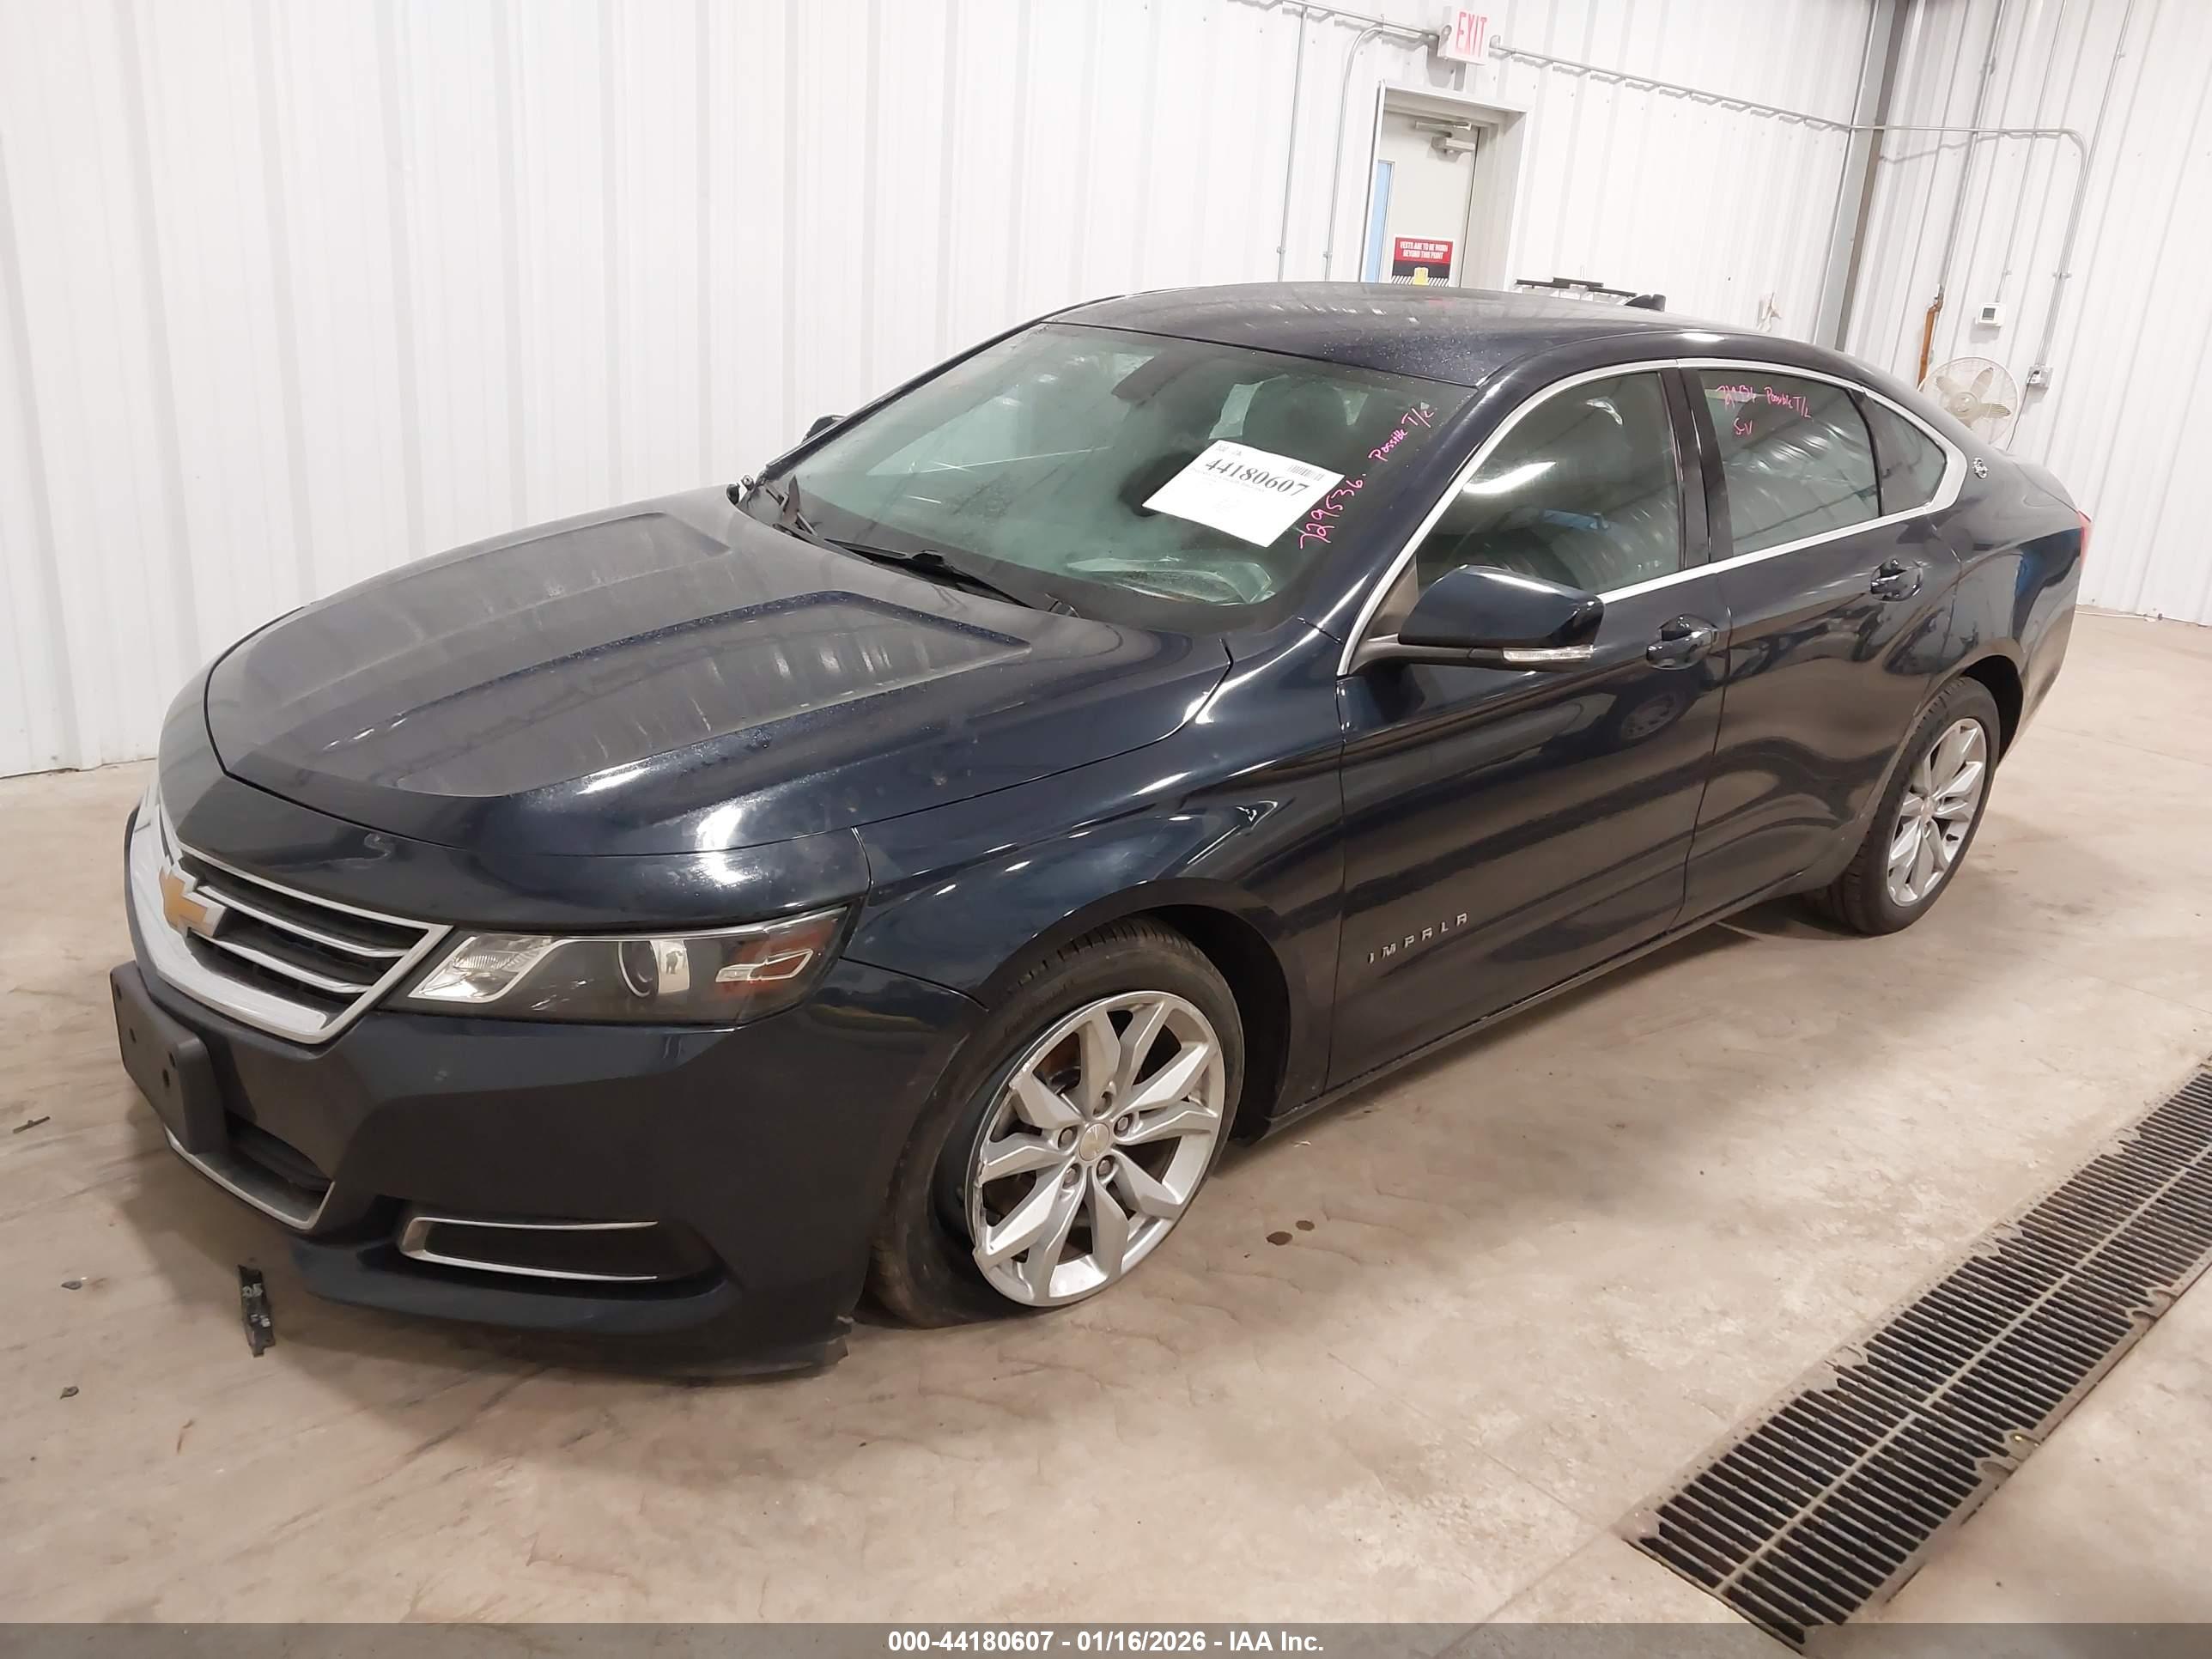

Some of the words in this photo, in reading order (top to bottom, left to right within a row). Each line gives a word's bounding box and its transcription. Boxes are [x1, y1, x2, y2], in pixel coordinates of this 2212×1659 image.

[1455, 11, 1487, 58] EXIT
[1205, 459, 1310, 496] 44180607
[1368, 913, 1468, 964] IMPALA
